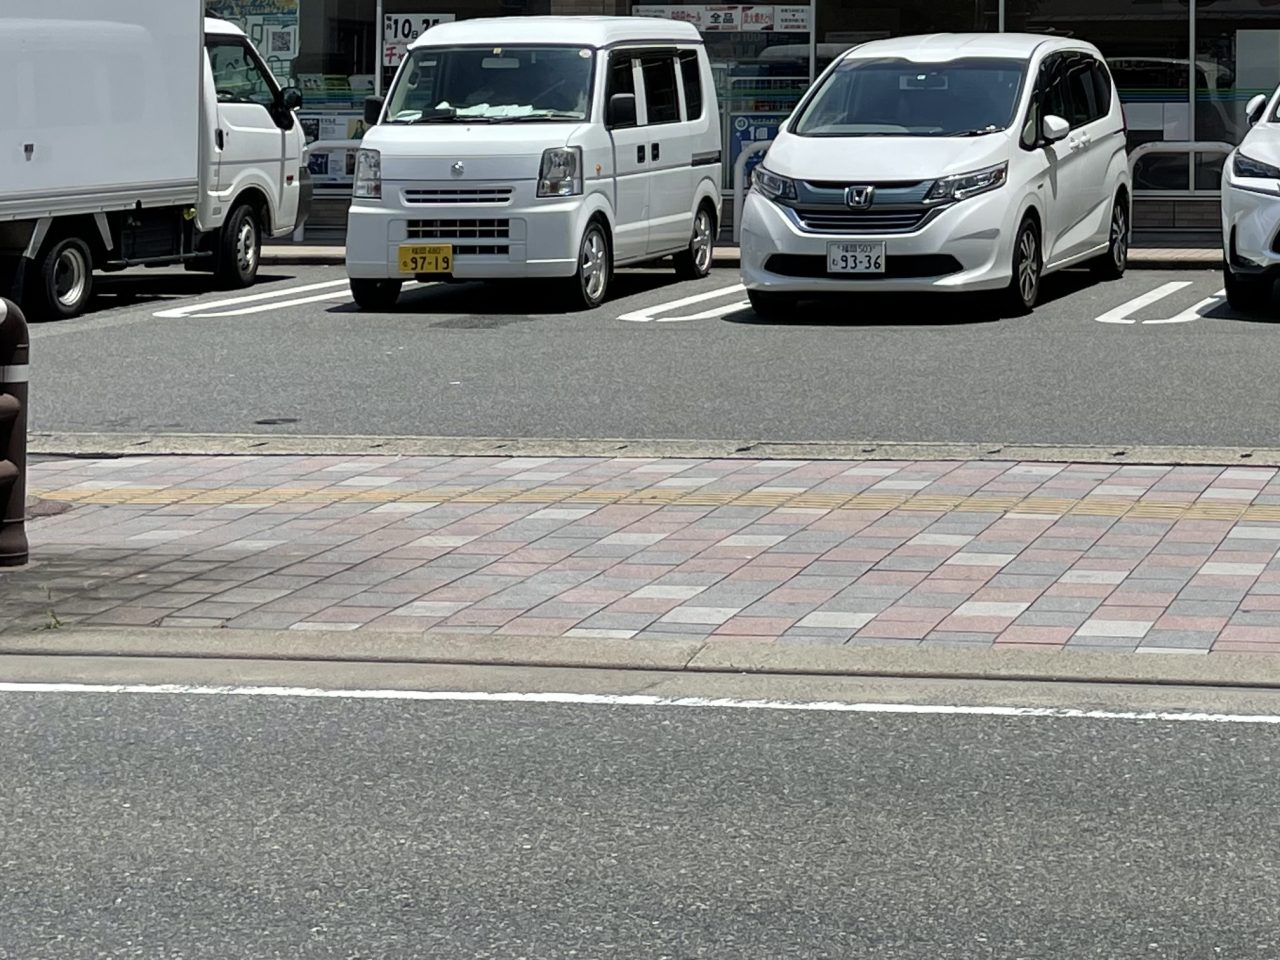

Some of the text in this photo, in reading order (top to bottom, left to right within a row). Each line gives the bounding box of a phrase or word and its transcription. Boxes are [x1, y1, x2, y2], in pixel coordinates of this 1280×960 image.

[710, 12, 734, 24] 全品
[410, 256, 450, 271] 97-19
[840, 254, 881, 270] 93-36
